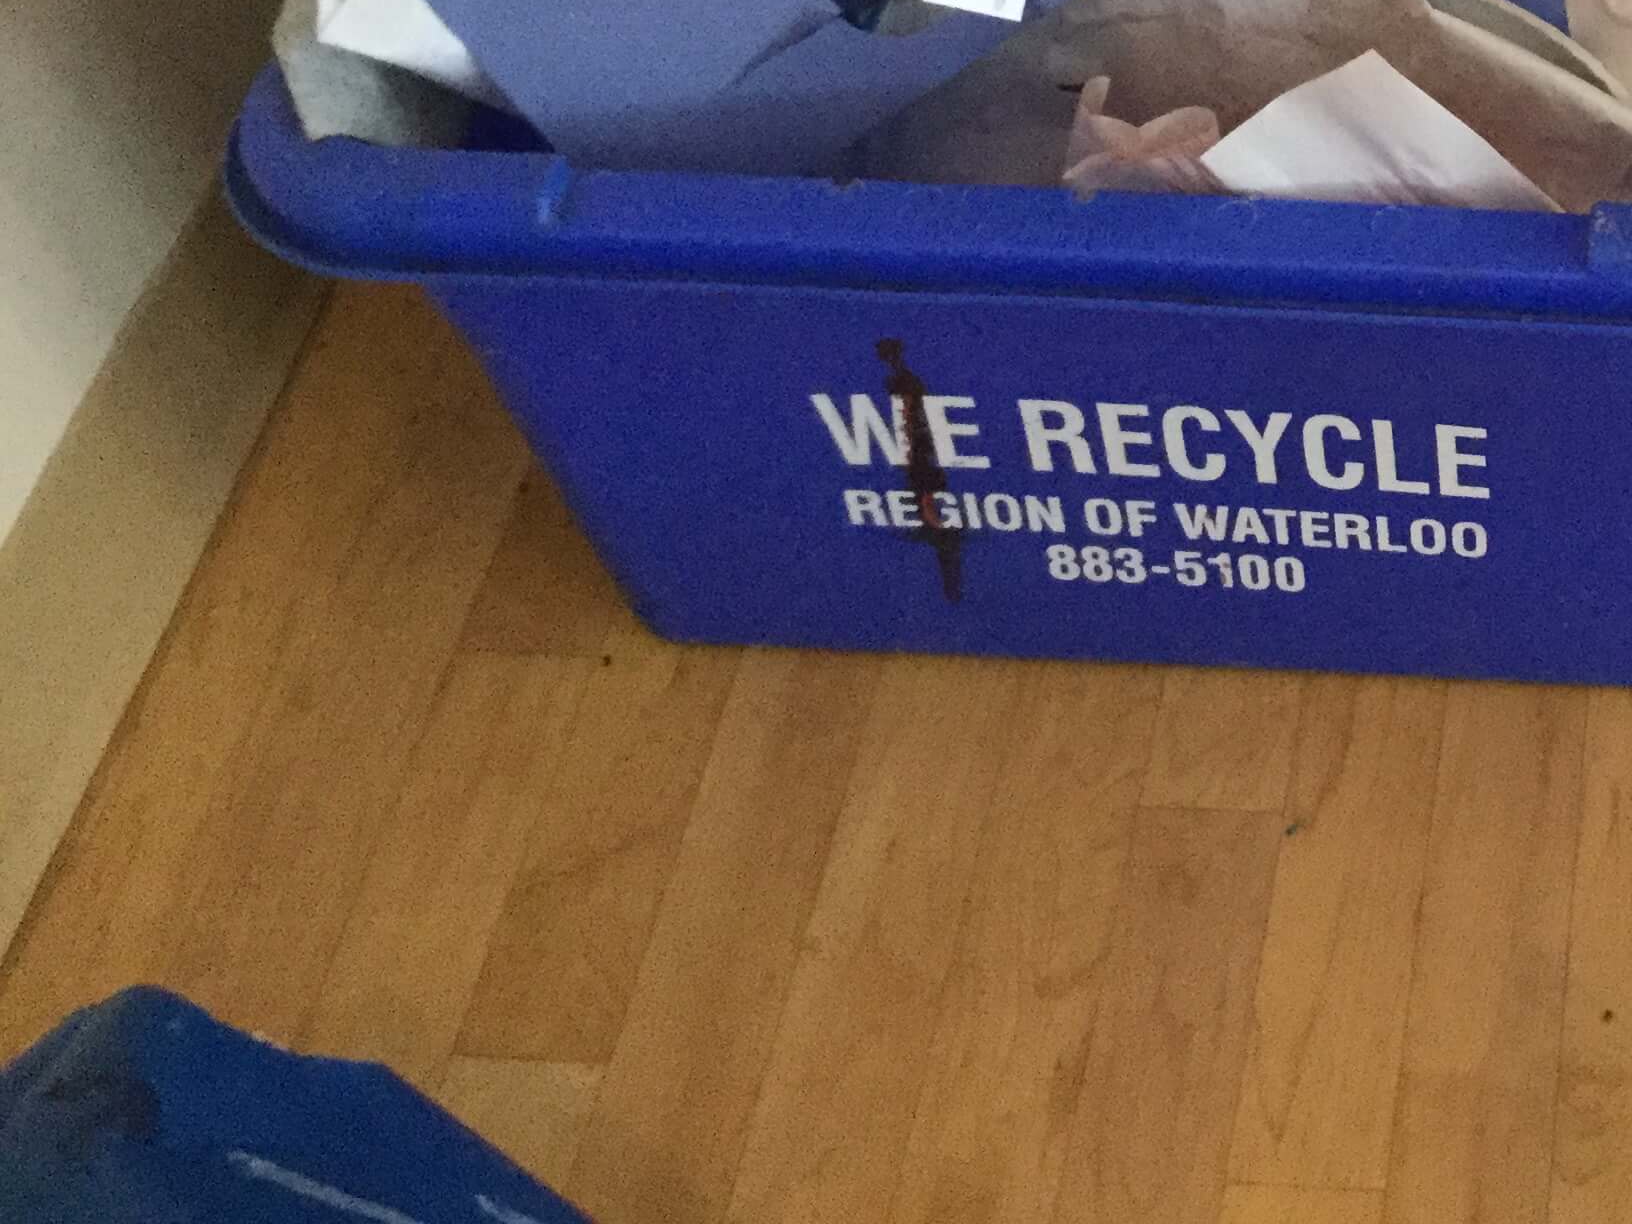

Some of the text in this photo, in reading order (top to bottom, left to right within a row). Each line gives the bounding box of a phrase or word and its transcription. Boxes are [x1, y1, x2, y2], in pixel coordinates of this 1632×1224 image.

[810, 393, 1491, 499] WE RECYCLE
[843, 489, 1488, 558] REGION OF WATERLOO
[1046, 544, 1306, 593] 883-5100
